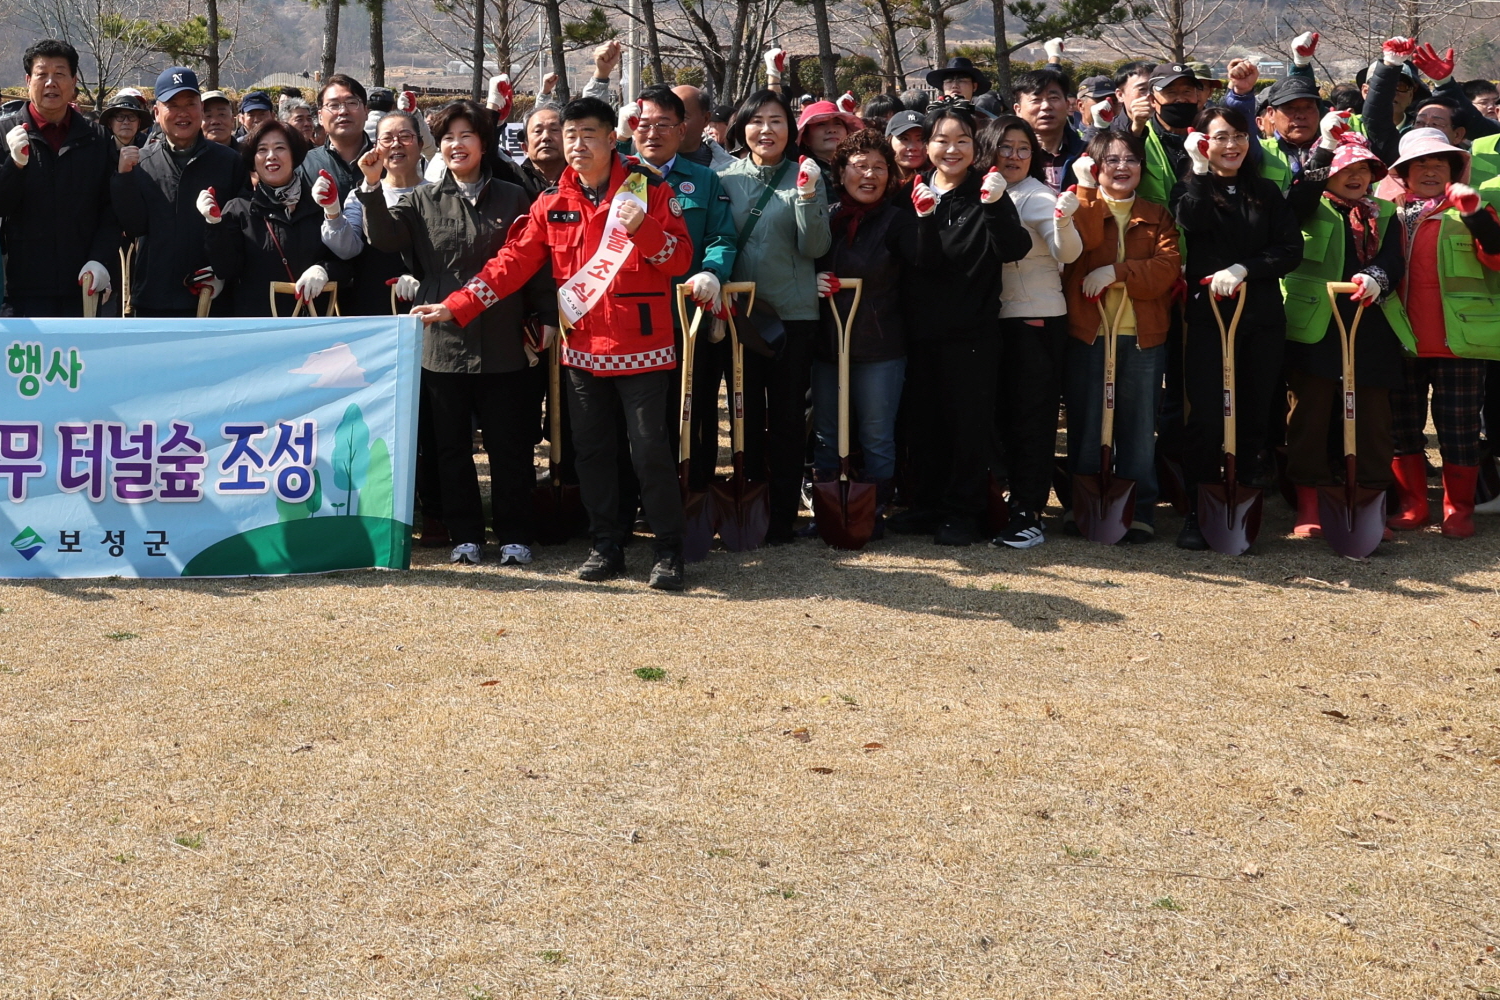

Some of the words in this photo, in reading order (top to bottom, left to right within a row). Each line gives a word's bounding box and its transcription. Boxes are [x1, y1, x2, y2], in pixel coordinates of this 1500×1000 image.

[7, 341, 83, 397] 행사
[58, 423, 205, 501] 터널숲
[218, 421, 314, 500] 조성
